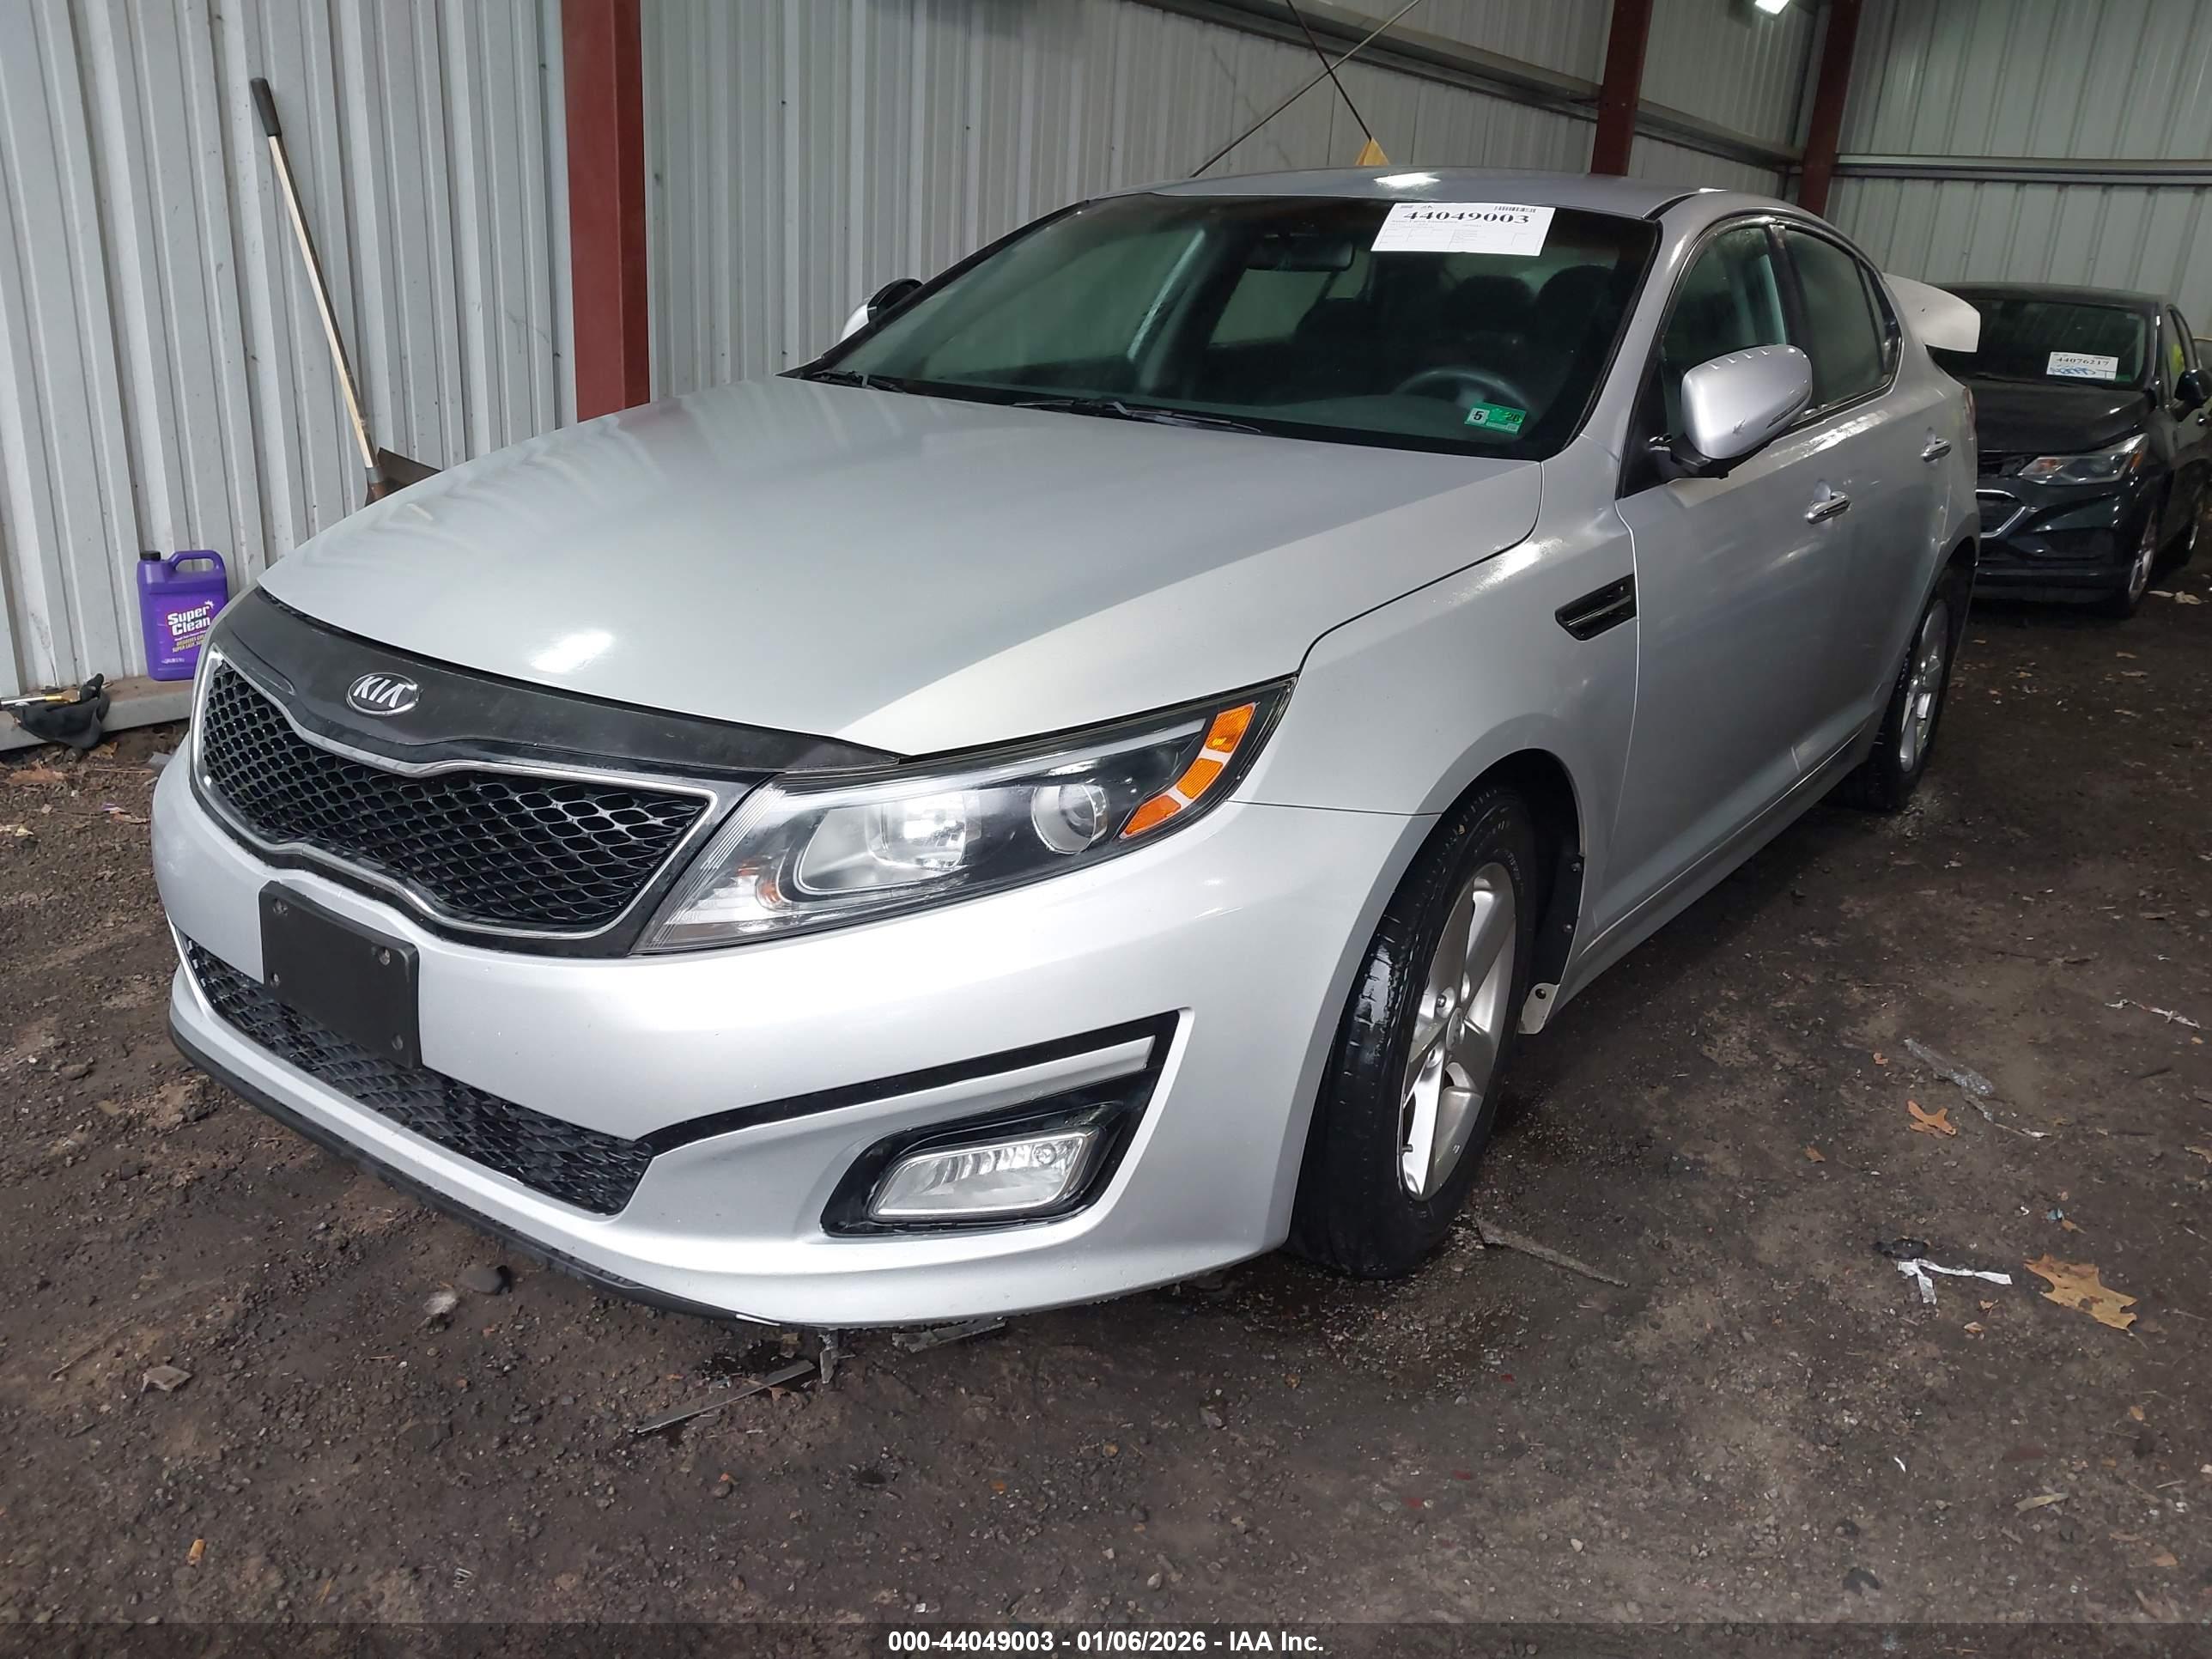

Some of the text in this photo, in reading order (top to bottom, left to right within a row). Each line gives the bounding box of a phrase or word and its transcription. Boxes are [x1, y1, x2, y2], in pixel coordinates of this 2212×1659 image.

[1404, 211, 1529, 224] 44049003
[2056, 357, 2110, 366] 44076217
[1474, 410, 1484, 420] 5
[167, 606, 210, 625] Super
[172, 617, 210, 635] Clean
[353, 676, 406, 708] KIA
